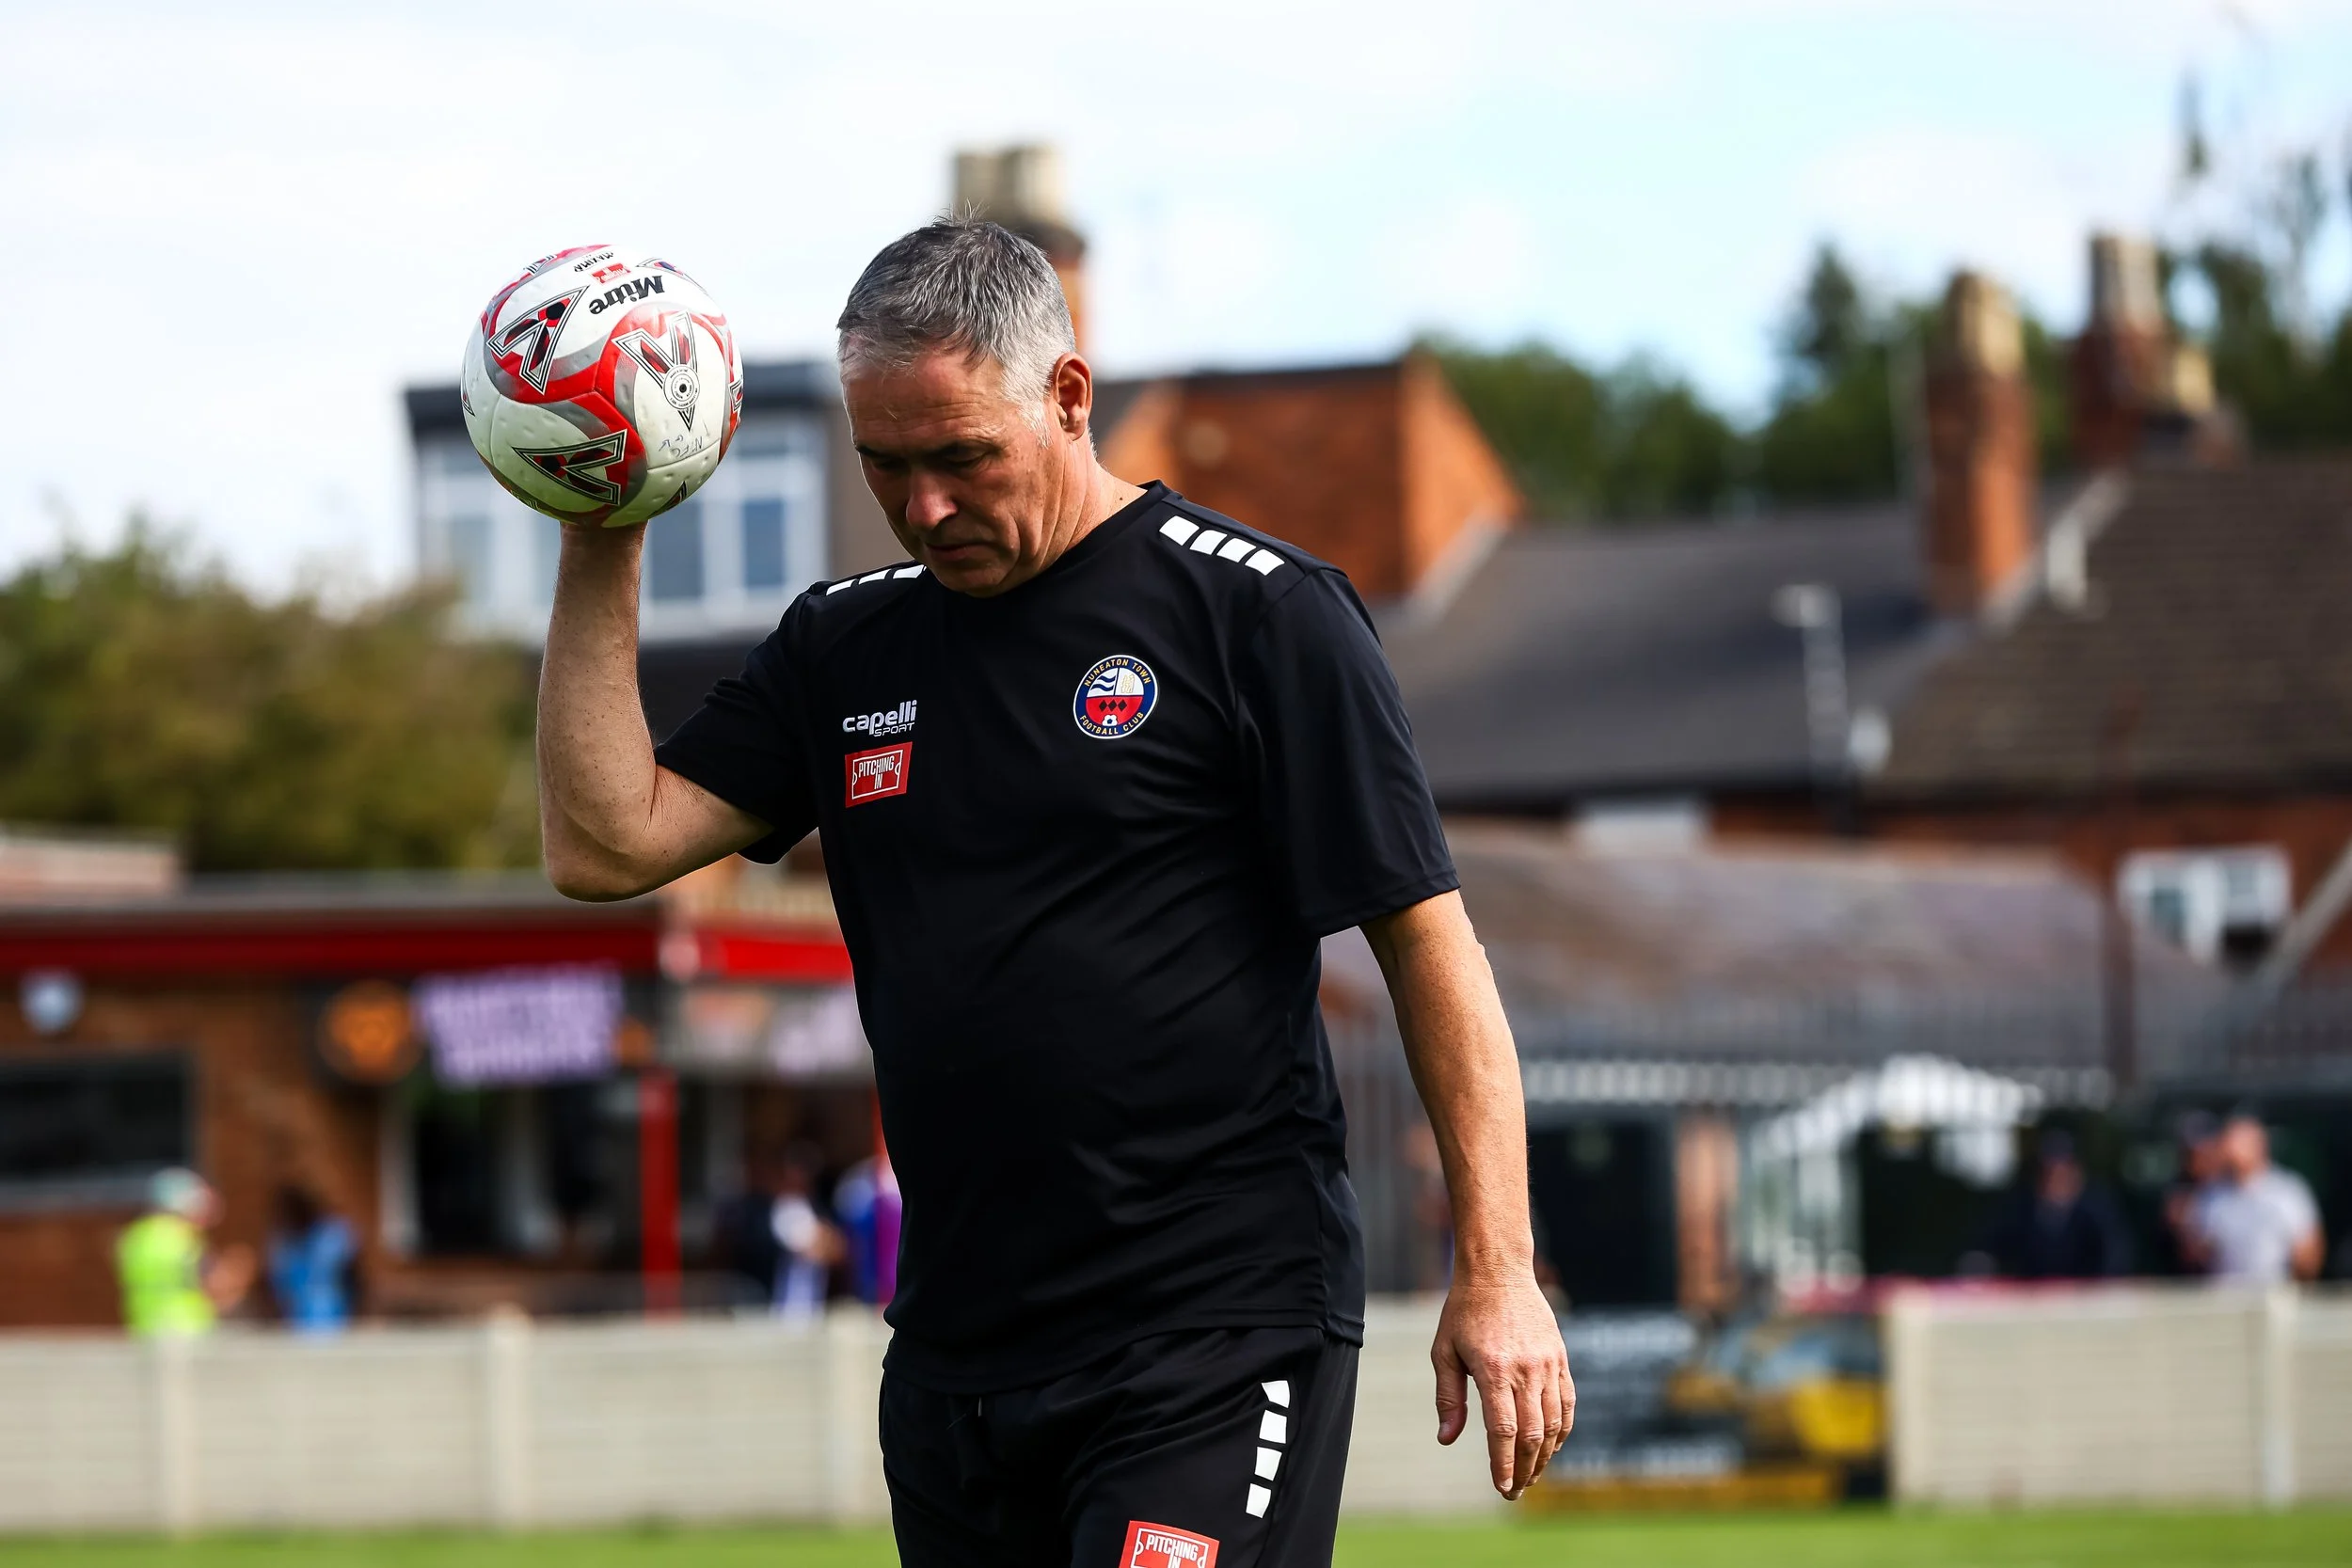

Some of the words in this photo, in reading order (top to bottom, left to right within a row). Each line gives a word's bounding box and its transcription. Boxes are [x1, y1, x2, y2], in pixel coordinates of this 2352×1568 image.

[588, 275, 666, 315] Mitre
[1084, 658, 1129, 687] NUNEATON
[1132, 662, 1152, 685] TOWN
[842, 700, 917, 735] capelli
[873, 721, 915, 737] SPORT
[1079, 715, 1119, 736] FOOTBALL
[1122, 712, 1144, 732] CLUB
[858, 755, 895, 777] PITCHING
[874, 773, 882, 789] IN
[1145, 1534, 1199, 1561] PITCHING
